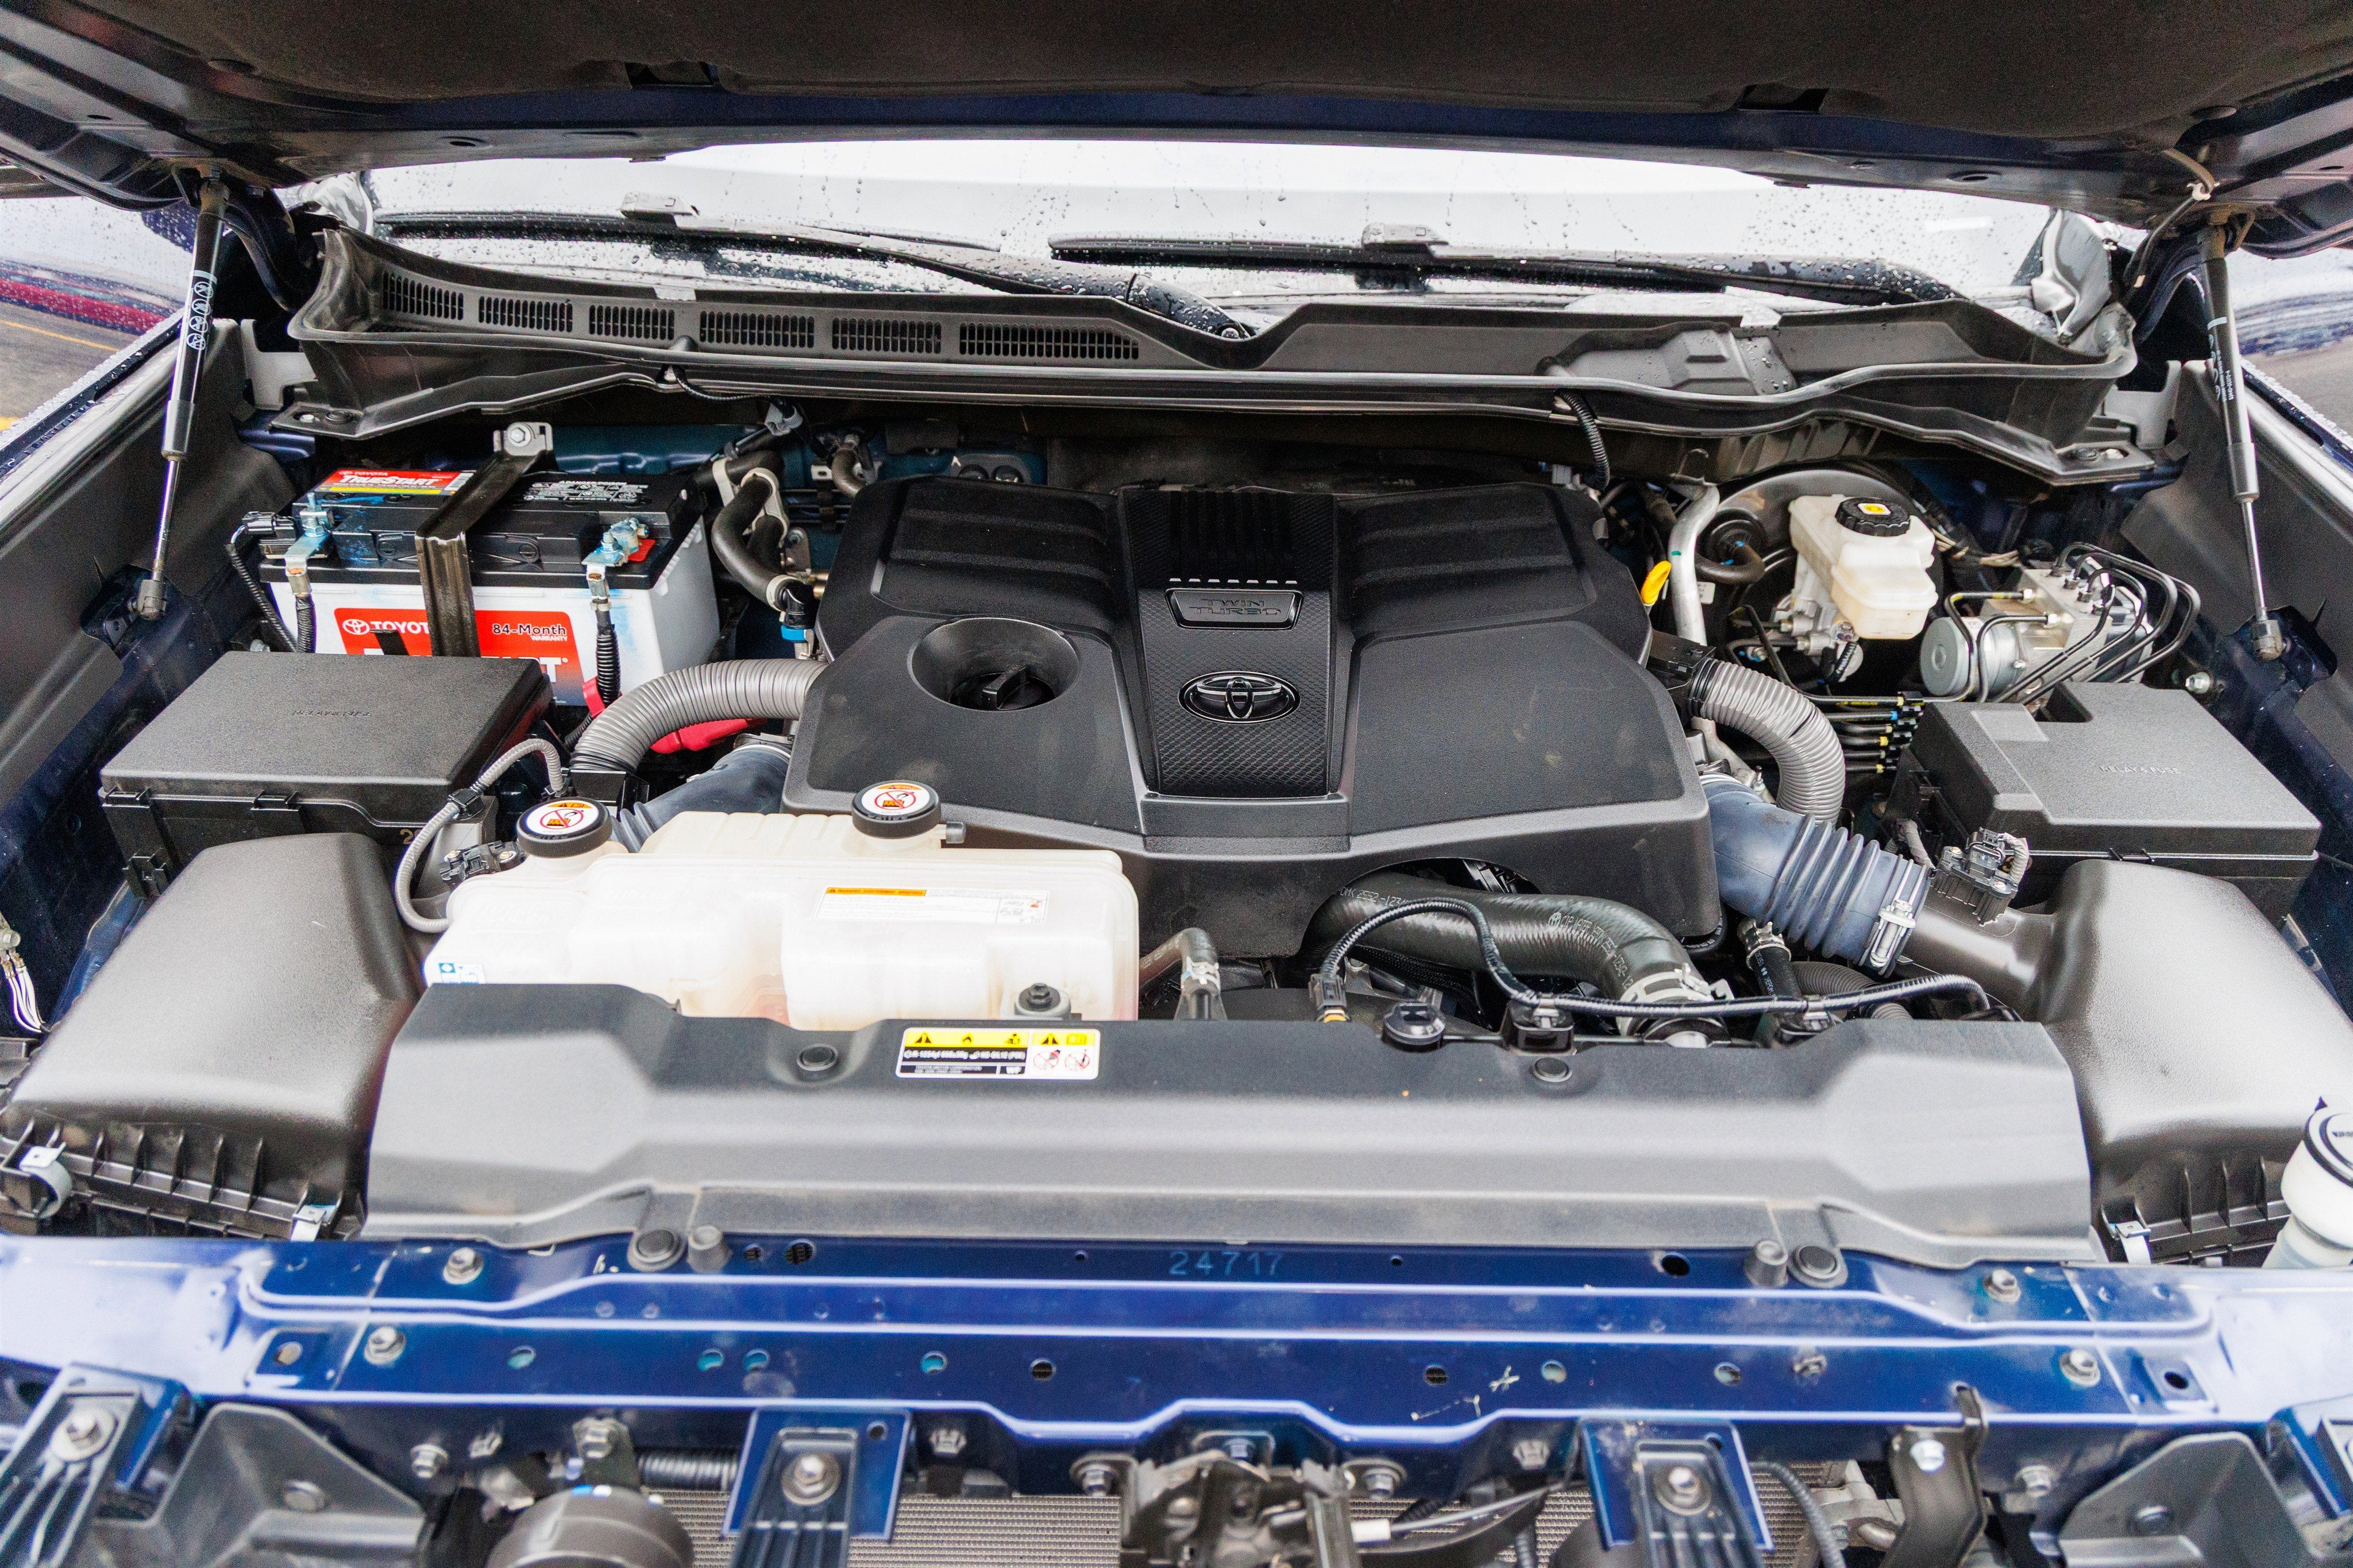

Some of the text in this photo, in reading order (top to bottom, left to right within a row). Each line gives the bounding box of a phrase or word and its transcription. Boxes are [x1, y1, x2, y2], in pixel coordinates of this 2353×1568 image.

[1200, 598, 1264, 607] TWIN
[1189, 607, 1282, 615] TURBO
[369, 620, 429, 634] TOYOT
[492, 623, 567, 636] 84-Month
[1168, 1249, 1284, 1276] 24717
